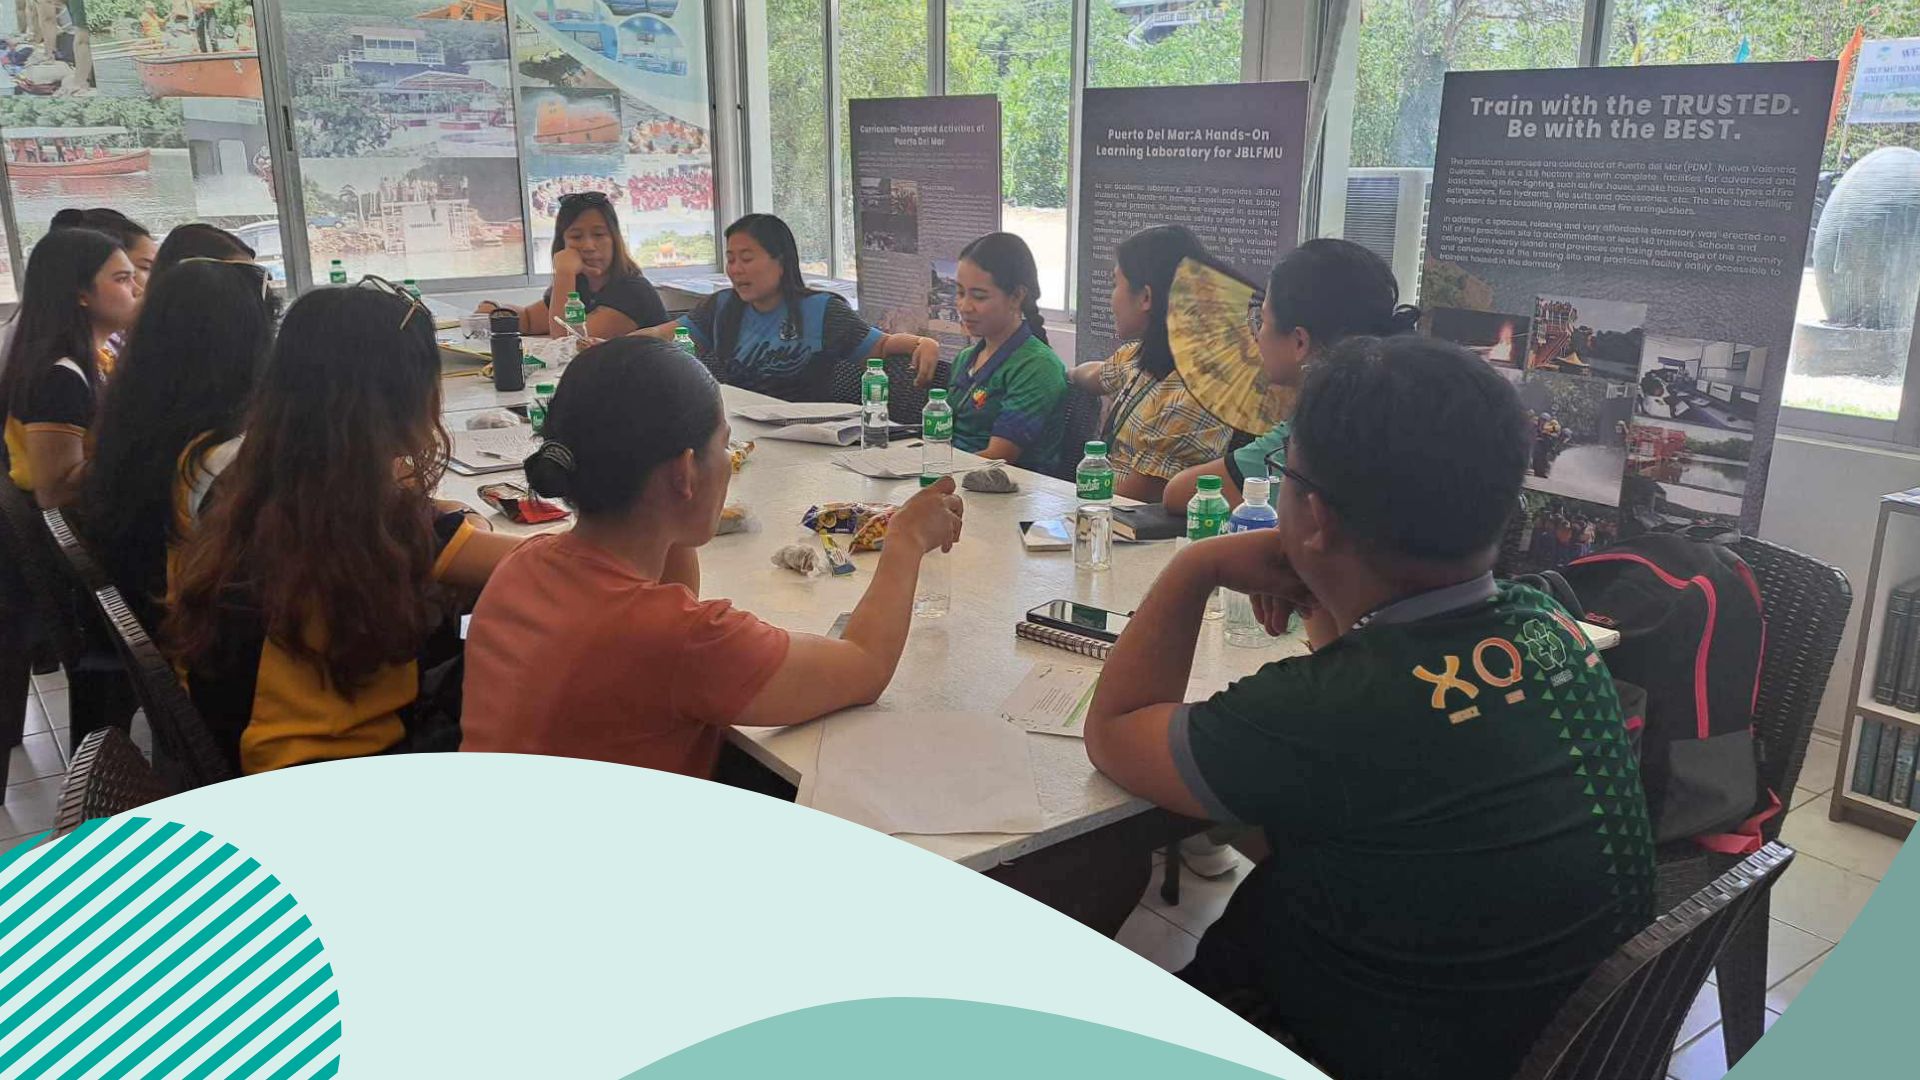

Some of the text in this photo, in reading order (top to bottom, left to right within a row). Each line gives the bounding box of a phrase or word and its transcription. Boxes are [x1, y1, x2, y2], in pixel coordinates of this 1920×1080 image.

[1470, 93, 1800, 116] Train with the TRUSTED.
[1107, 129, 1144, 141] Puerto
[1147, 129, 1165, 141] Del
[1205, 129, 1271, 141] Hands-On
[1507, 116, 1742, 140] Be with the BEST.
[894, 137, 917, 146] Puerto
[931, 138, 945, 146] Mar
[1096, 144, 1284, 162] Learning Laboratory for JBLFMU
